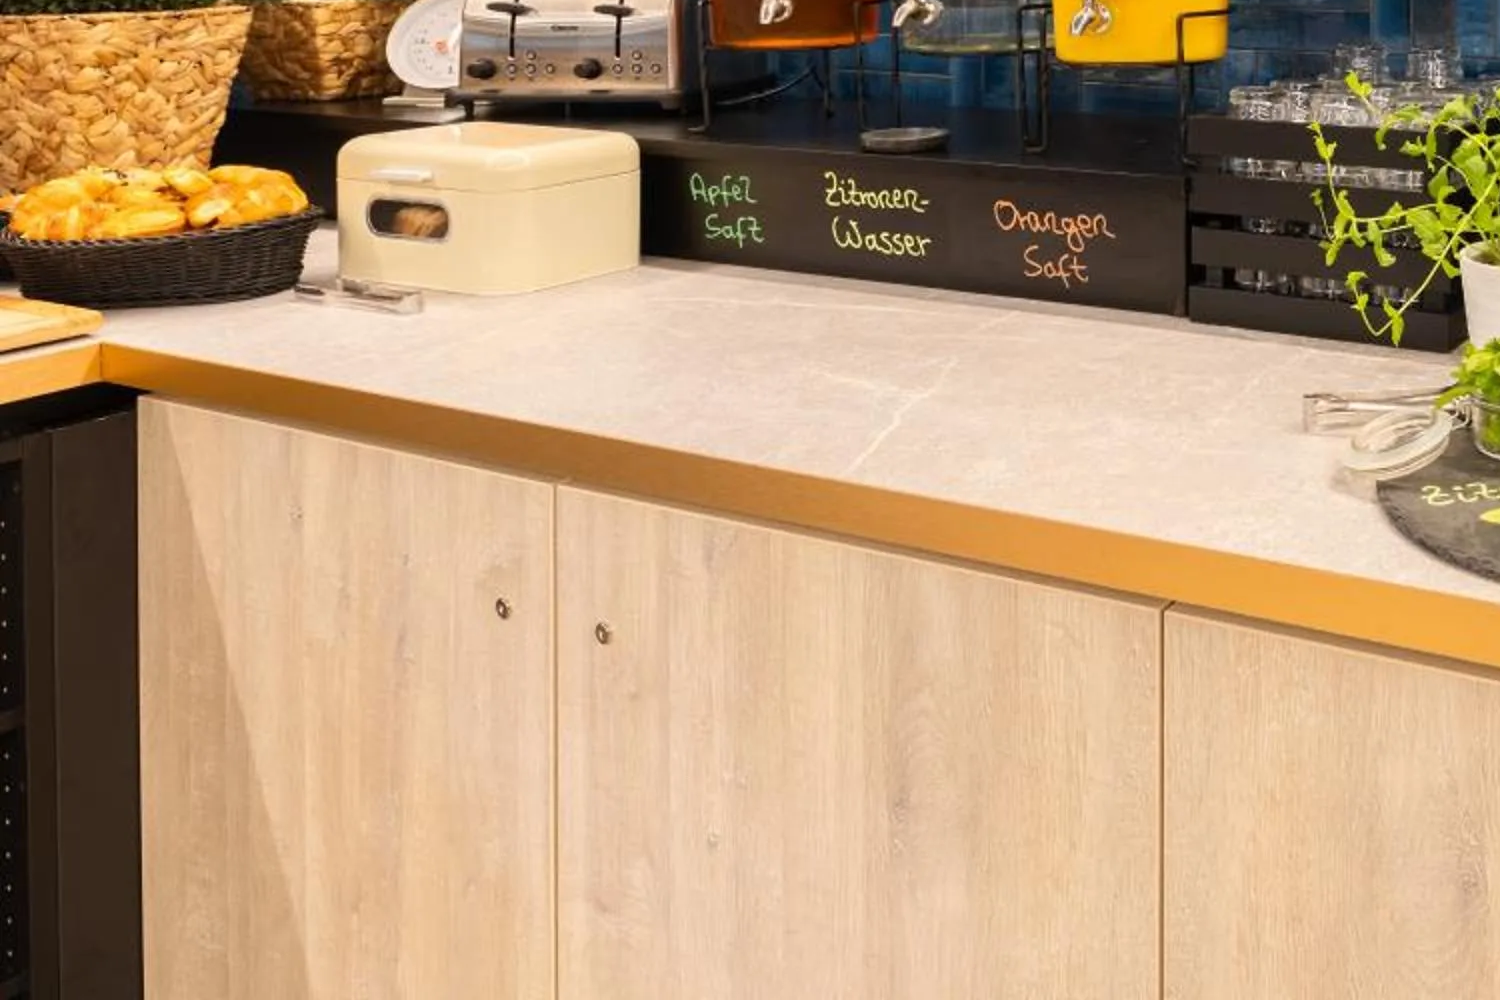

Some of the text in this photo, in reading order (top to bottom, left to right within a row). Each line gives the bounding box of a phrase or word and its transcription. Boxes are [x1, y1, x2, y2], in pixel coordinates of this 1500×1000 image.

[689, 172, 758, 208] Apfel
[824, 171, 930, 213] Zitronen-
[705, 213, 765, 249] Saft
[831, 215, 932, 257] Wasser
[993, 199, 1117, 253] Orangen
[1023, 244, 1089, 289] Saft
